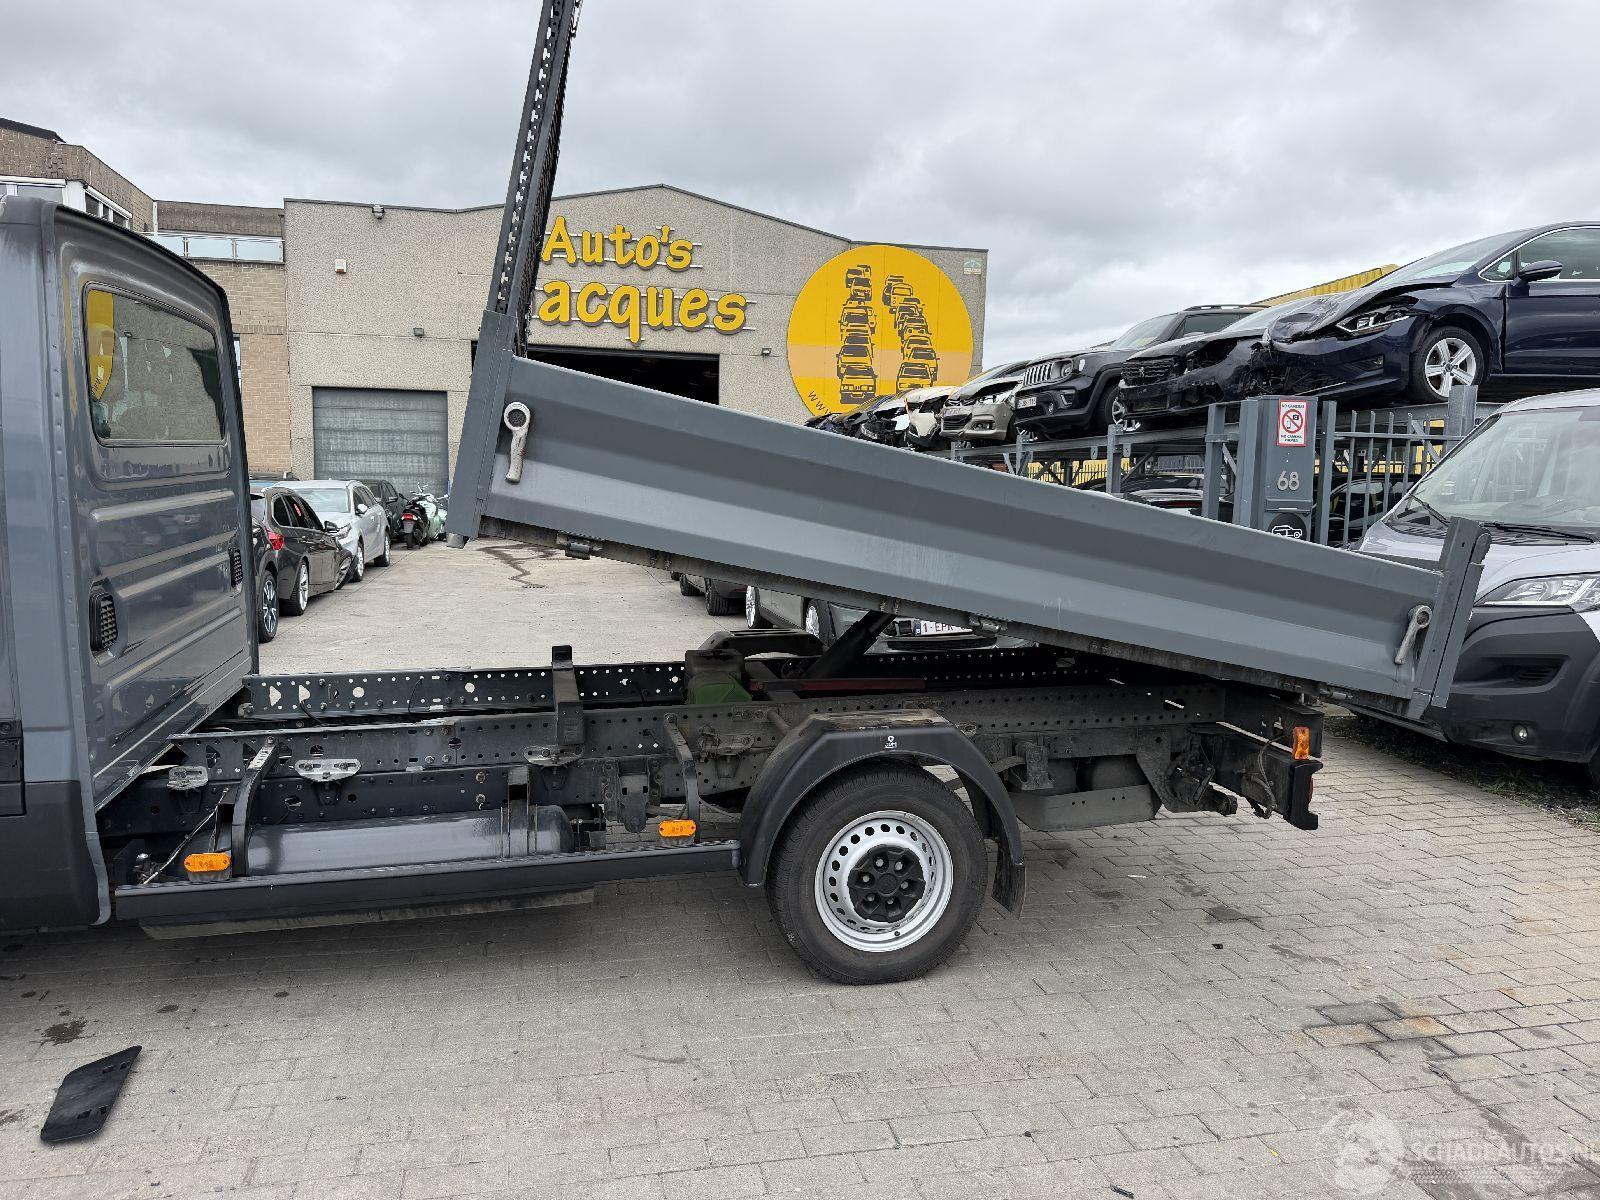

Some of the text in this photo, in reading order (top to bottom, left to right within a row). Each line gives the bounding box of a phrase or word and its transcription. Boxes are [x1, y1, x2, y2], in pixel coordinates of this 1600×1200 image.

[542, 215, 693, 271] Auto's
[538, 281, 747, 344] acques
[1277, 470, 1300, 491] 68
